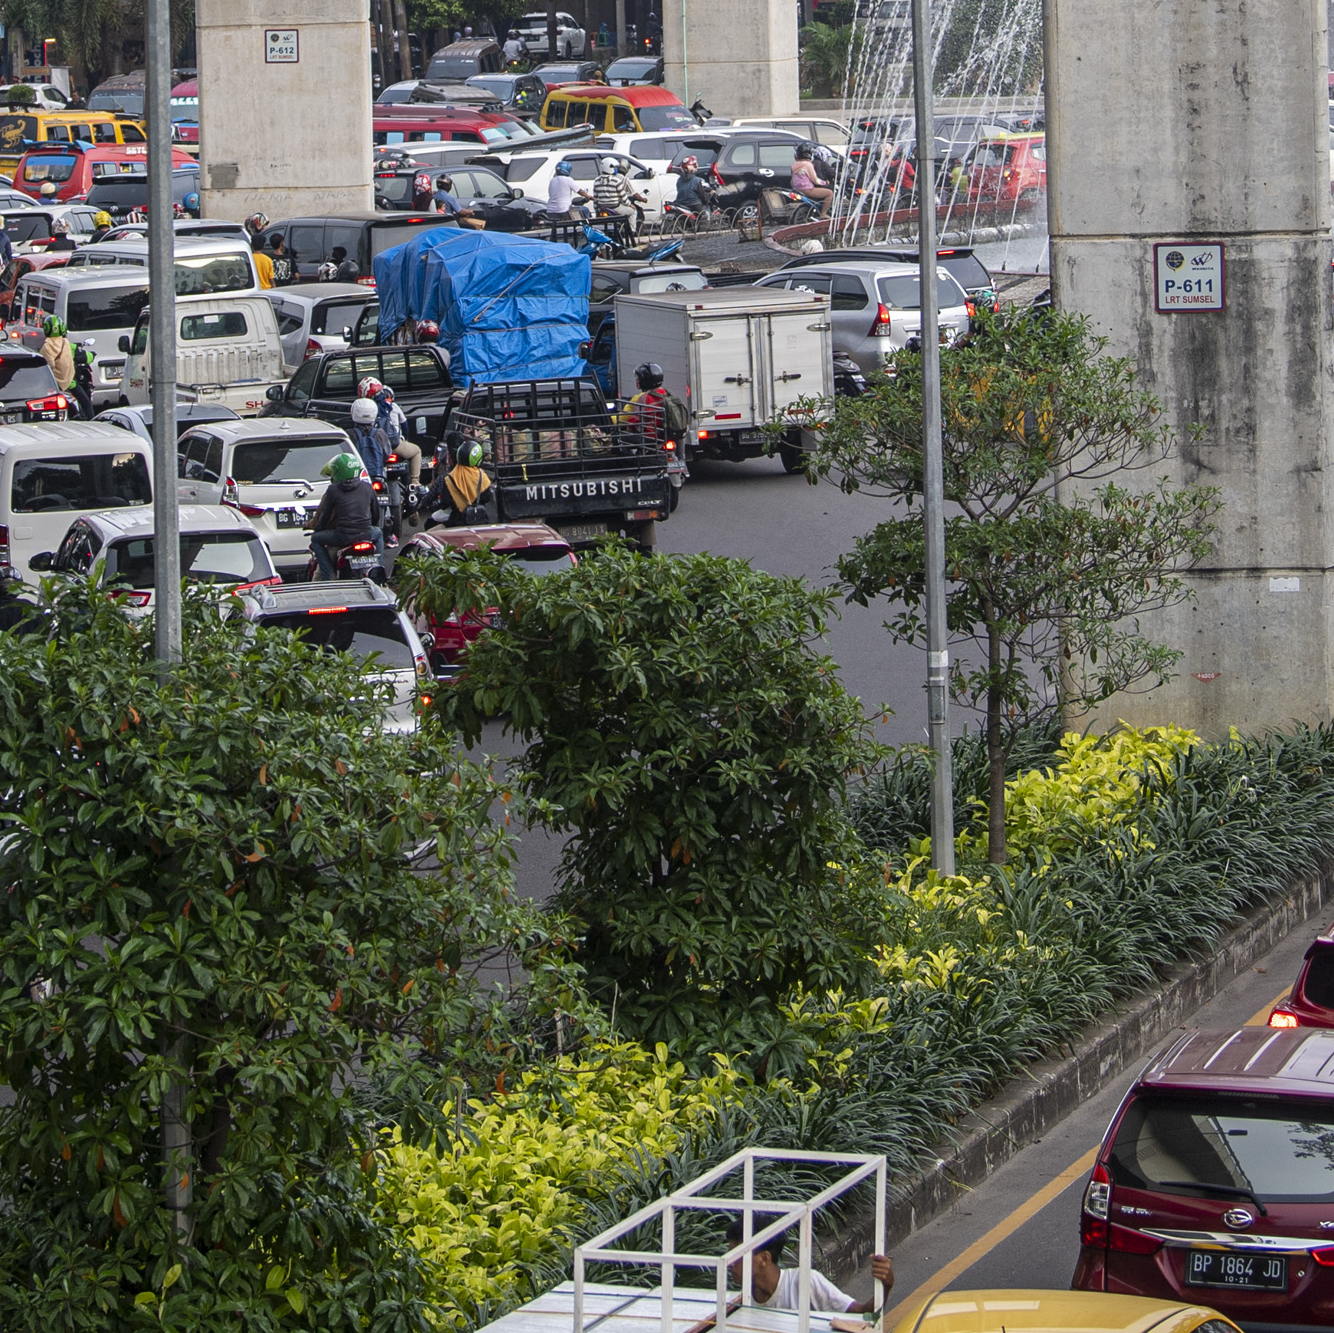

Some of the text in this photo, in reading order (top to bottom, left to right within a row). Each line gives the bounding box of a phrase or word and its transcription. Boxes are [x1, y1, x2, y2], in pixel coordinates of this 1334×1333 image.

[1165, 279, 1214, 294] P-611
[1165, 295, 1215, 304] LRT SUMSEL
[526, 478, 643, 500] MITSUBISHI
[279, 513, 288, 522] BG
[1193, 1254, 1280, 1278] BP 1864 JD
